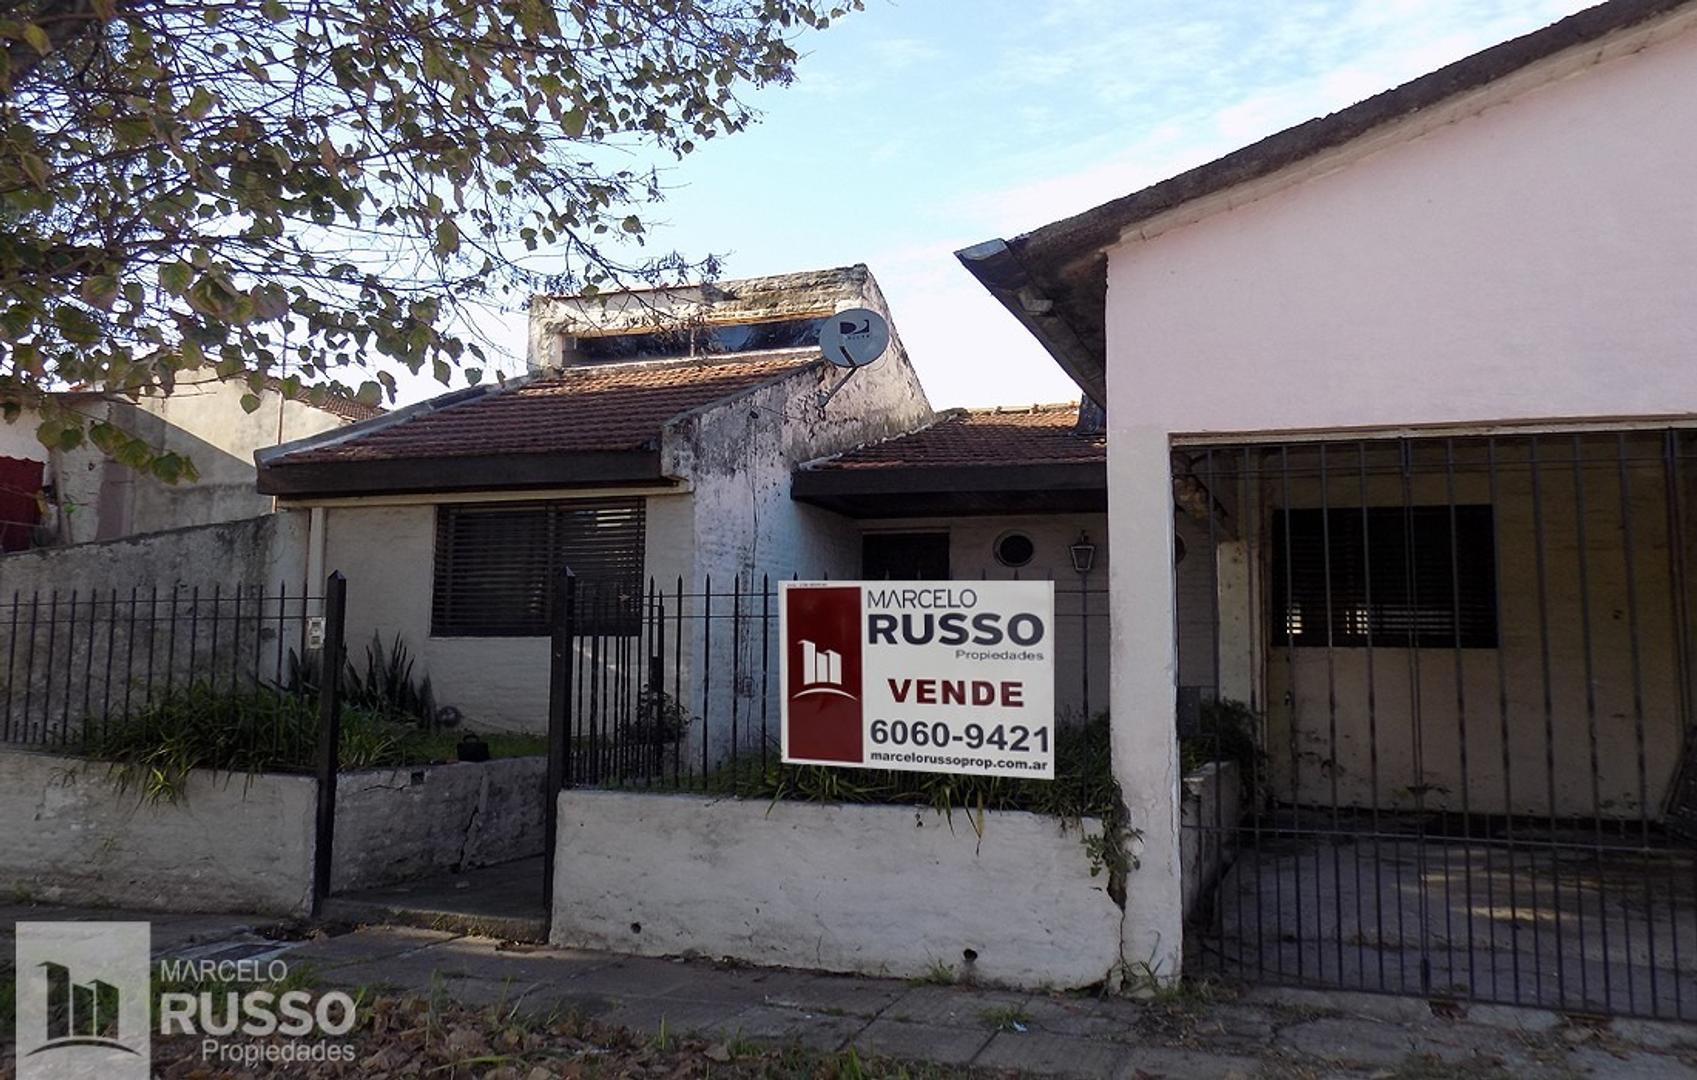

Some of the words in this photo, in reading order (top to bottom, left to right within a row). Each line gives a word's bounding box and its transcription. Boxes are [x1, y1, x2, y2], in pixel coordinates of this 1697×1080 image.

[868, 589, 977, 609] MARCELO
[868, 613, 1044, 646] RUSSO
[955, 650, 1044, 661] Propiedades
[888, 678, 1024, 707] VENDE
[870, 719, 1049, 752] 6060-9421
[870, 752, 1048, 771] marcelorussoprop.com.ar
